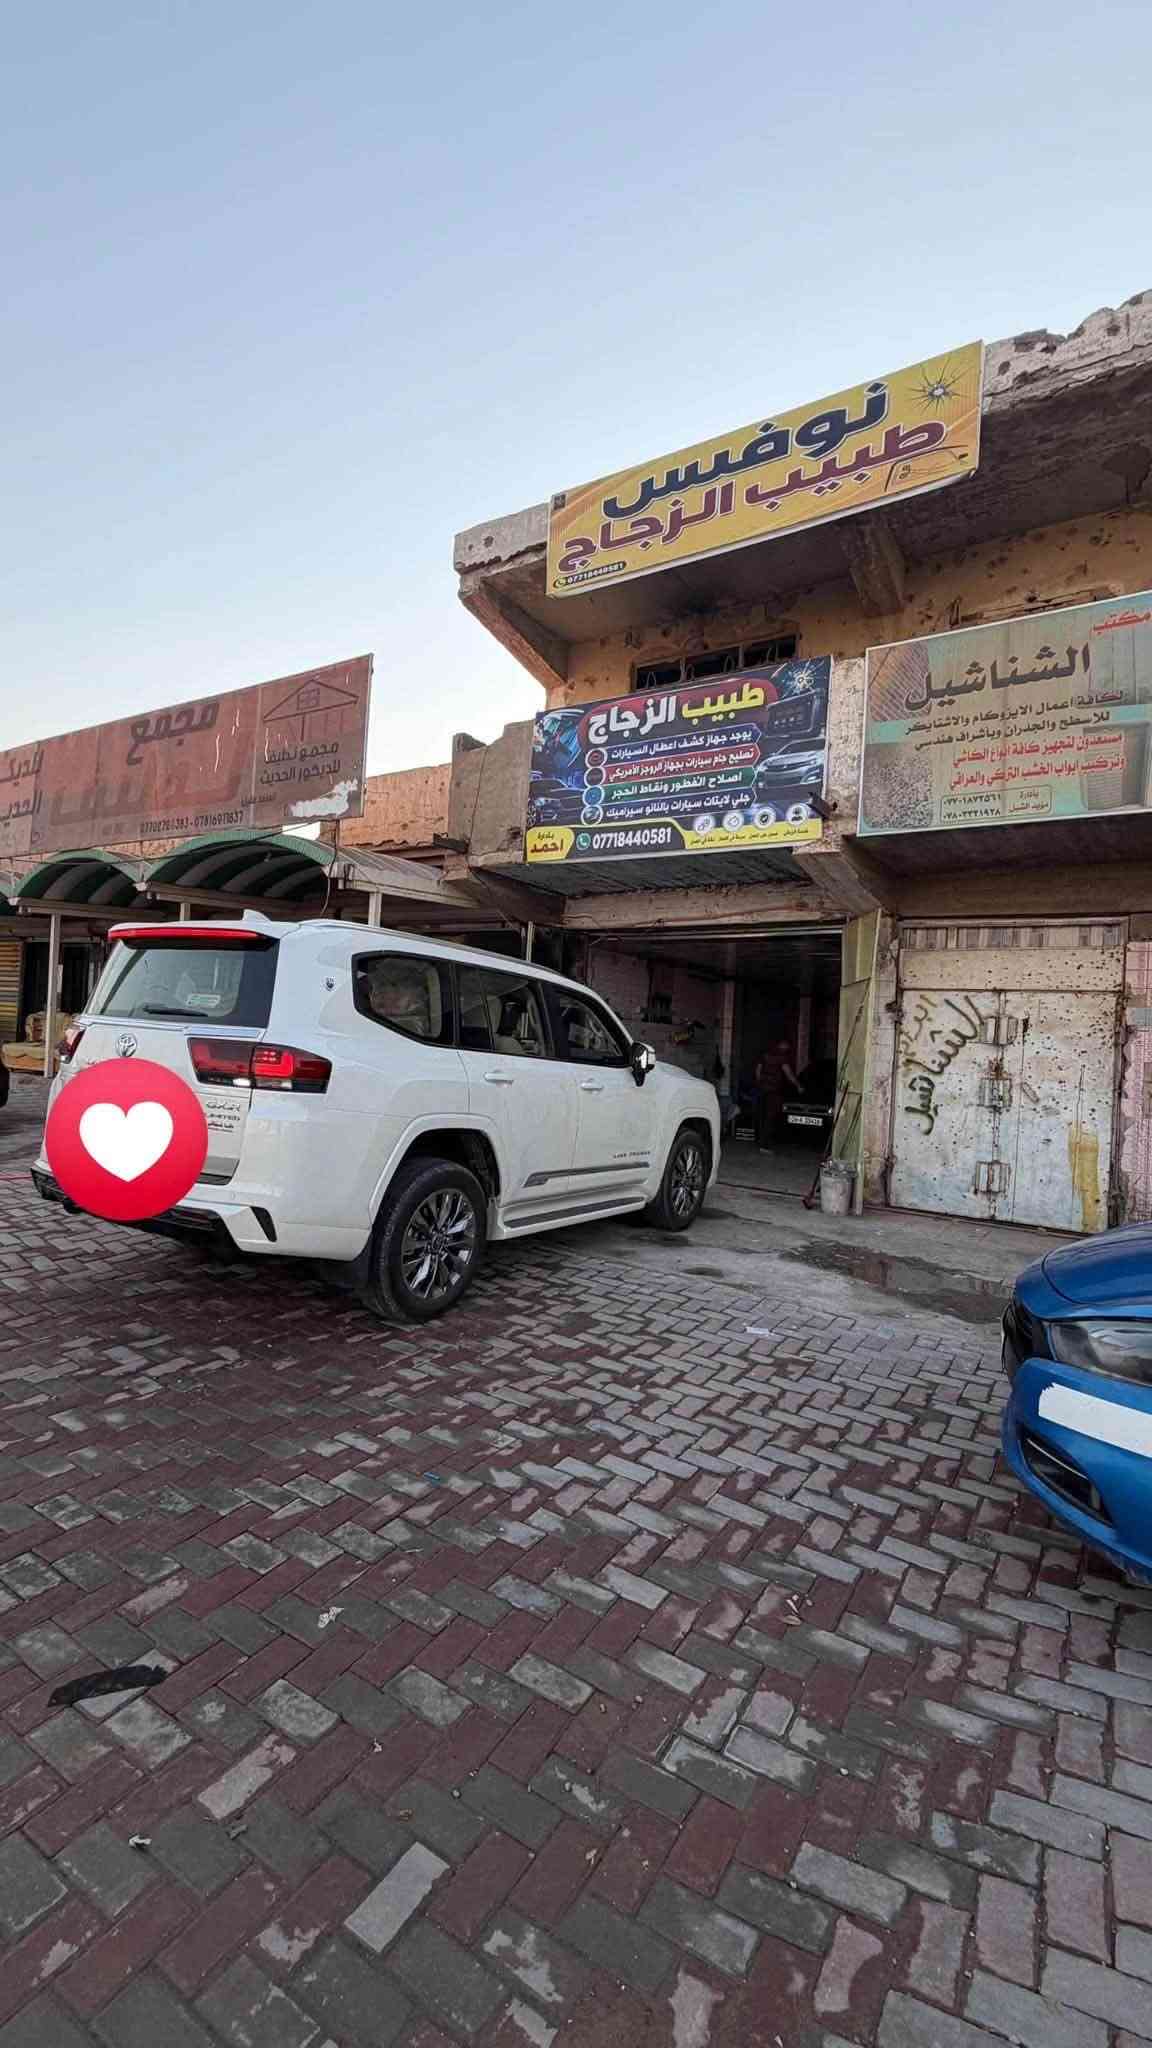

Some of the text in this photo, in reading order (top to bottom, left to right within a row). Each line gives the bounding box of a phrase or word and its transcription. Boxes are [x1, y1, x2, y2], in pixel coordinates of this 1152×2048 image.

[558, 421, 946, 574] طبيب الزجاج
[904, 641, 1091, 711] الشناشيل
[1036, 696, 1073, 715] اعمال
[588, 683, 764, 745] طبيب الزجاج
[1060, 711, 1110, 731] للاسطح
[126, 701, 220, 765] مجمع
[1004, 719, 1057, 738] والجدران
[611, 729, 752, 759] يوجد جهاز كشف اعطال السيارات
[1011, 741, 1040, 754] كافة
[663, 760, 685, 772] بجهاز
[686, 755, 711, 769] سيارات
[713, 754, 727, 767] جام
[640, 782, 668, 793] ونقاط
[708, 772, 742, 789] اصلاح
[611, 786, 638, 800] الحجر
[731, 793, 750, 808] جلي
[606, 807, 643, 818] سيراميك
[671, 799, 701, 811] سيارات
[592, 827, 671, 849] 07718440581
[530, 839, 564, 854] احمد
